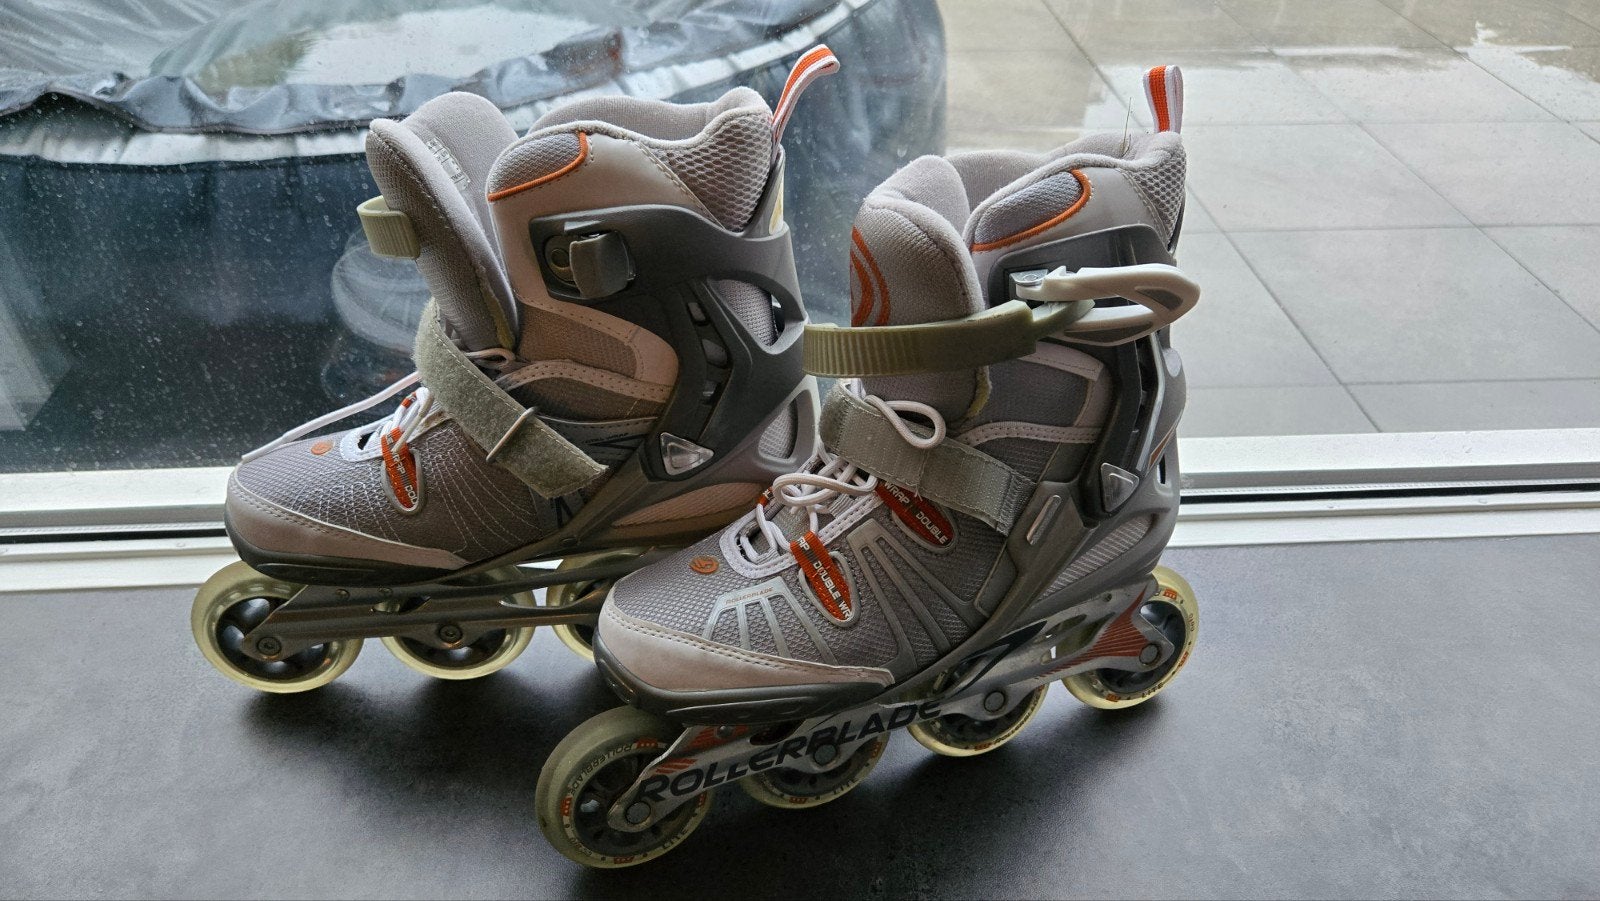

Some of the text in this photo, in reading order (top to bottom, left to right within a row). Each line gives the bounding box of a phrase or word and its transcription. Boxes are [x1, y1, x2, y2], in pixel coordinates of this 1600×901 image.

[884, 481, 948, 545] WRAP DOUBLE
[812, 560, 842, 600] DOUBLE
[637, 701, 942, 803] ROLLERBLADE
